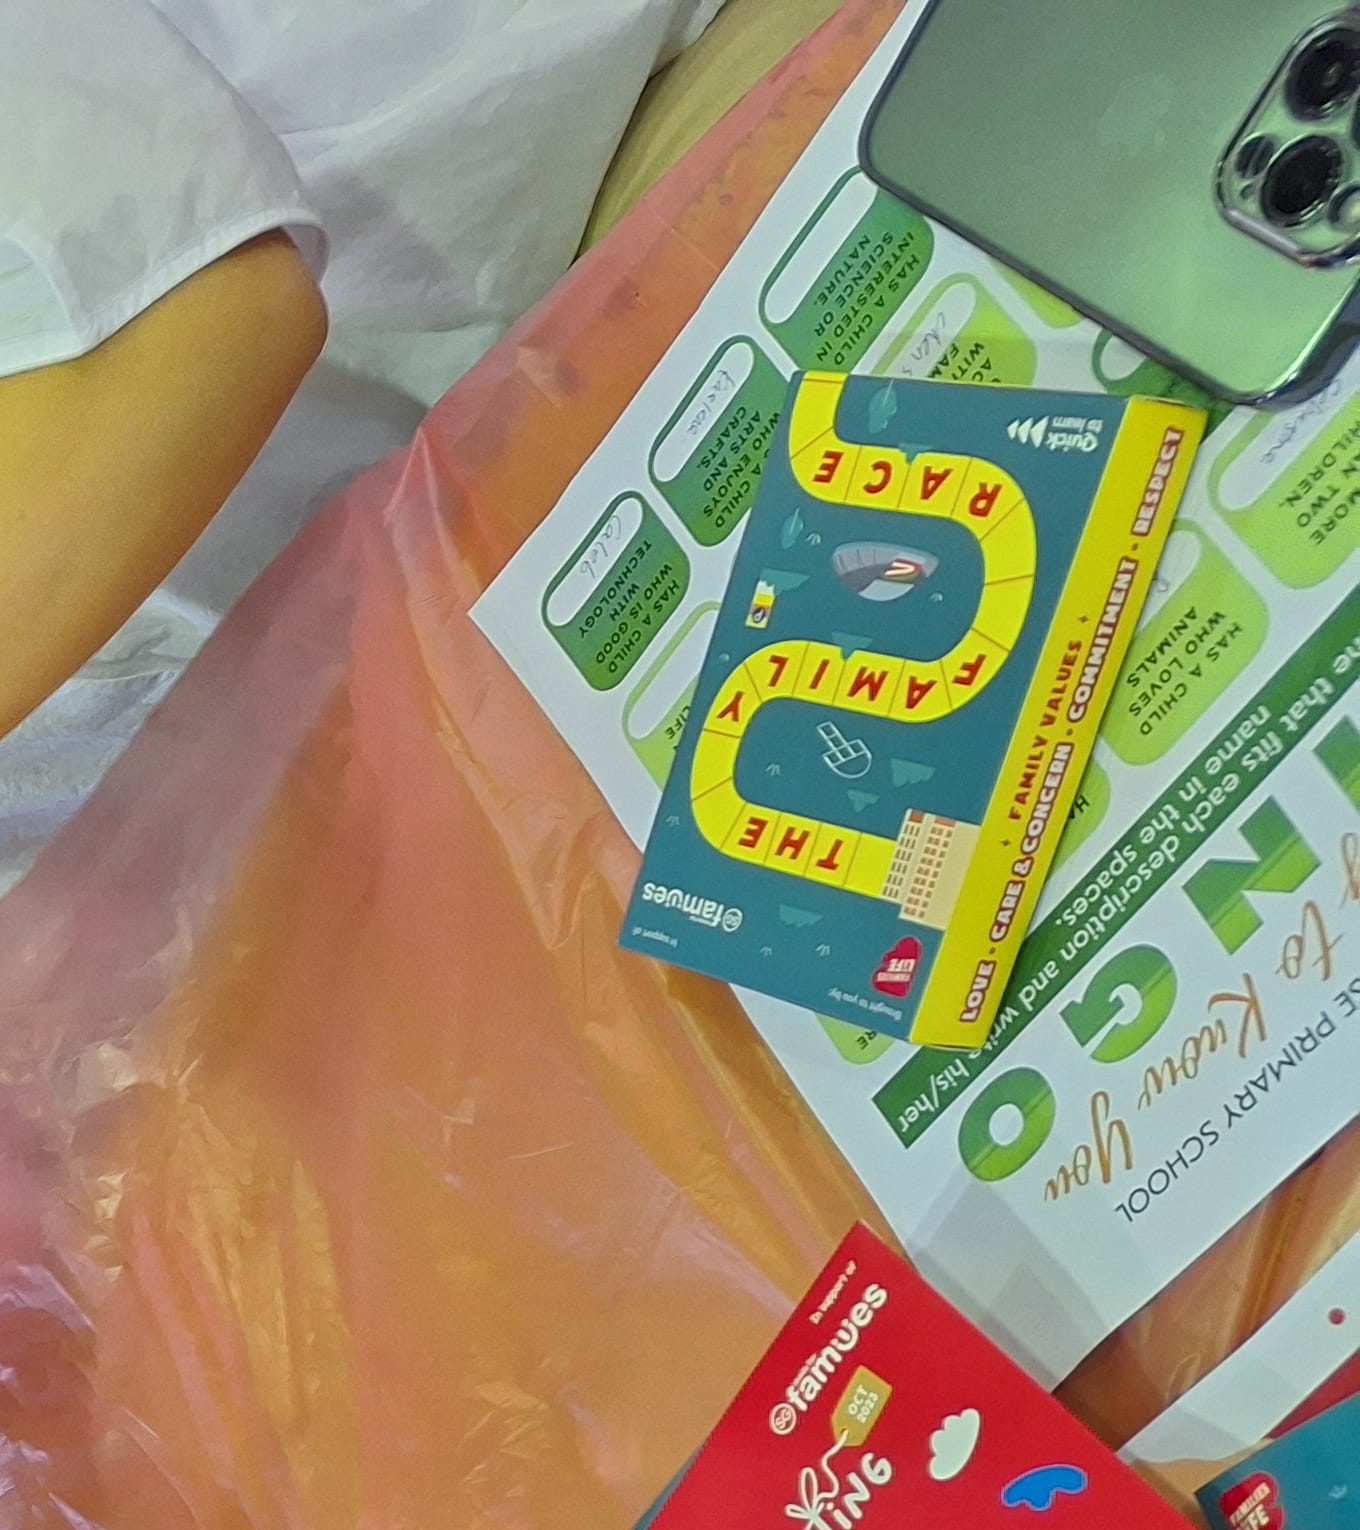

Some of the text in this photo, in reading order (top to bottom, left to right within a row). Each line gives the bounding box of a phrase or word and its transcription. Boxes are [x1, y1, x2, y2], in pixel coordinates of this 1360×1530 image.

[811, 234, 872, 308] NATURE.
[812, 232, 895, 336] SCIENCE OR
[814, 231, 917, 362] INTERESTED IN
[830, 253, 920, 366] HAS A CHILD
[694, 405, 749, 471] CRAFTS.
[728, 410, 764, 452] ARTS
[748, 411, 784, 453] WHO
[1044, 431, 1097, 451] Quick
[699, 454, 731, 492] AND
[700, 453, 753, 516] ENJOYS
[711, 464, 763, 529] A CHILD
[812, 447, 1001, 517] RACE
[1294, 480, 1339, 531] TWO
[573, 540, 653, 638] TECHNOLOGY
[593, 562, 673, 664] WHO IS GOOD
[606, 581, 640, 621] WITH
[605, 579, 680, 673] HAS A CHILD
[1124, 602, 1199, 691] ANIMALS
[716, 653, 986, 723] FAMILY
[1127, 607, 1225, 719] WHO LOVES
[1137, 620, 1242, 739] HAS A CHILD
[959, 425, 1183, 1025] LOVE CARE & CONCERN COMMITMENT RESPECT
[1008, 637, 1082, 822] FAMILY VALUES
[1278, 675, 1335, 731] that
[1240, 730, 1285, 774] fits
[1055, 703, 1272, 932] name in the spaces.
[1179, 768, 1241, 837] each
[738, 811, 844, 874] THE
[1057, 831, 1185, 961] description
[1014, 959, 1060, 1010] and
[1046, 900, 1327, 1202] to Know You
[893, 1057, 972, 1131] his/her
[1114, 1011, 1339, 1222] PRIMARY SCHOOL
[808, 1259, 858, 1324] In support of
[845, 1384, 869, 1415] OCT
[855, 1391, 880, 1423] 2023
